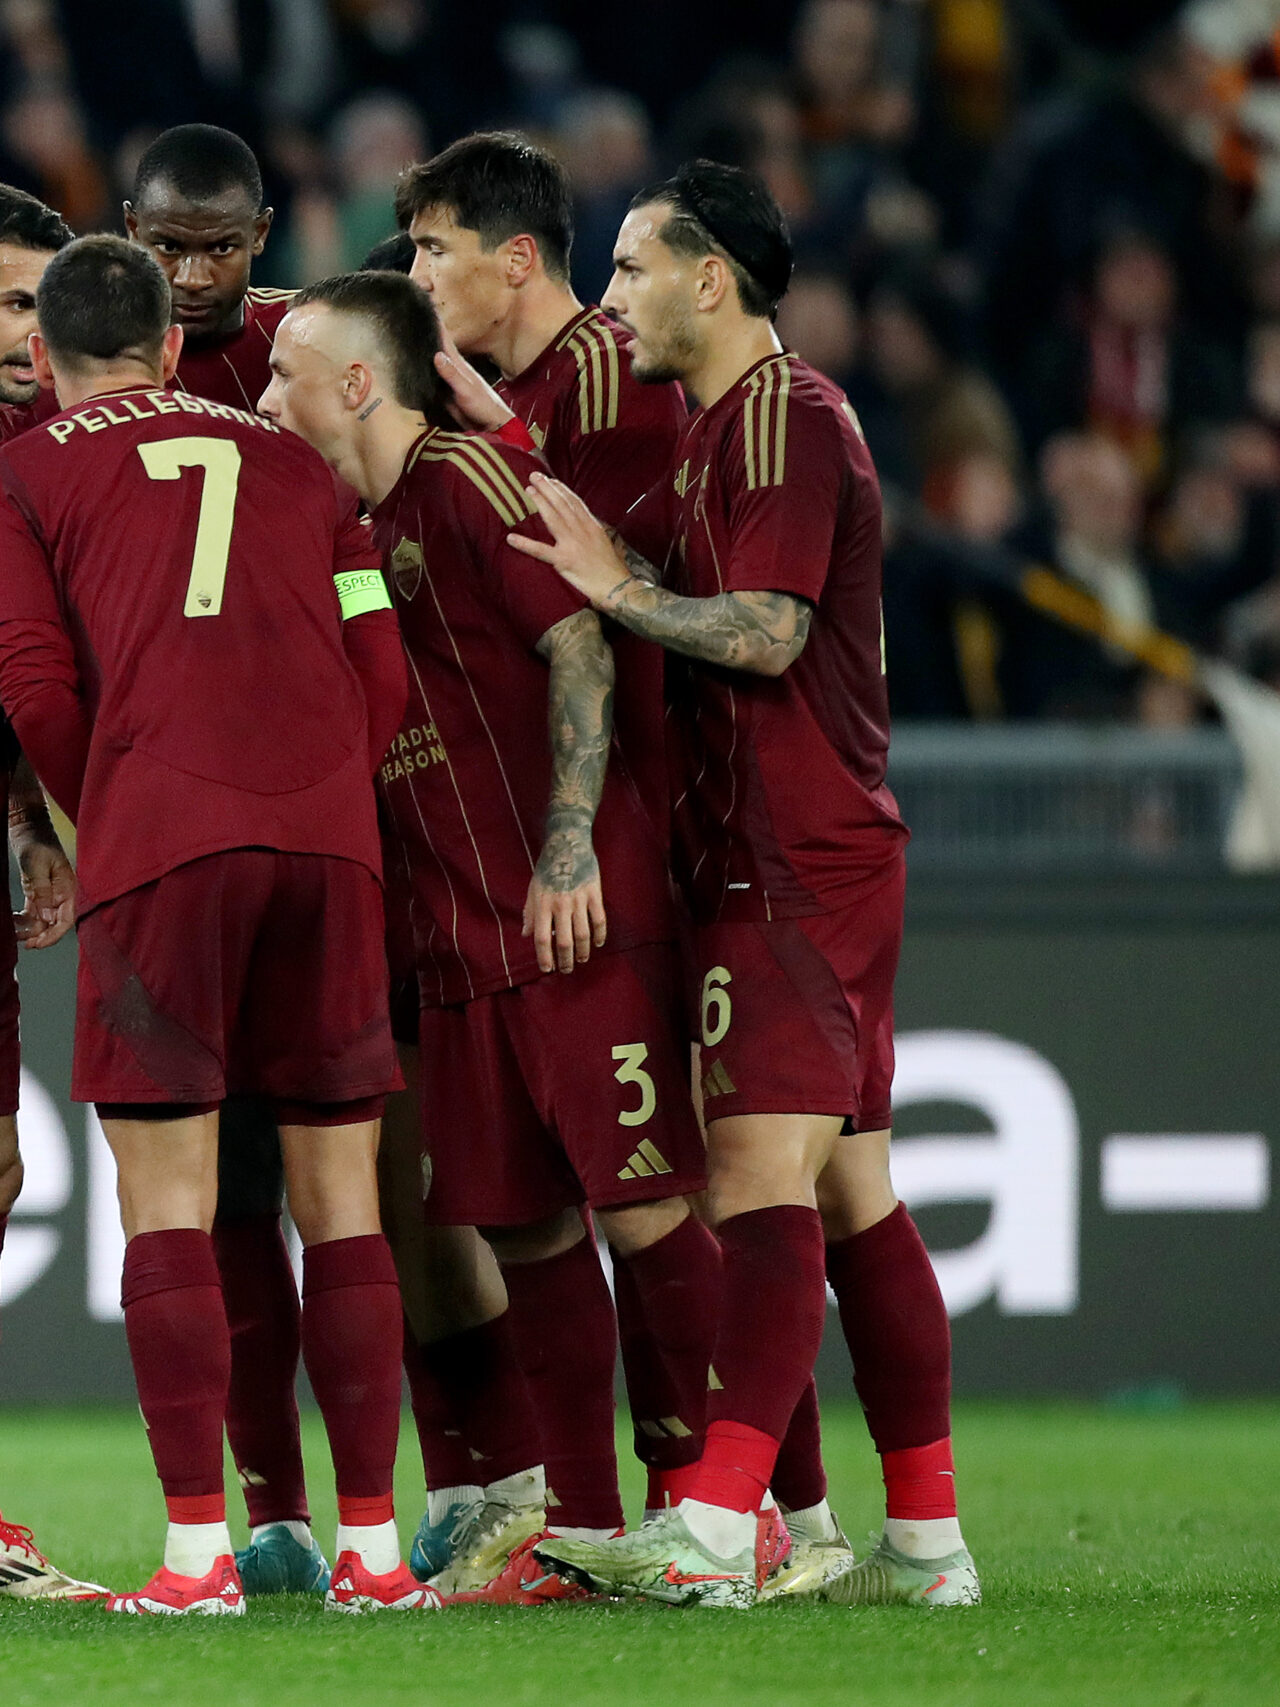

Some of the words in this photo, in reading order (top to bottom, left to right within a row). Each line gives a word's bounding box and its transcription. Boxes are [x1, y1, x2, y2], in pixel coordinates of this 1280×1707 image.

[136, 435, 242, 618] 7
[381, 744, 446, 784] SEASON
[384, 722, 438, 758] YADH
[701, 965, 732, 1047] 6
[611, 1042, 657, 1127] 3
